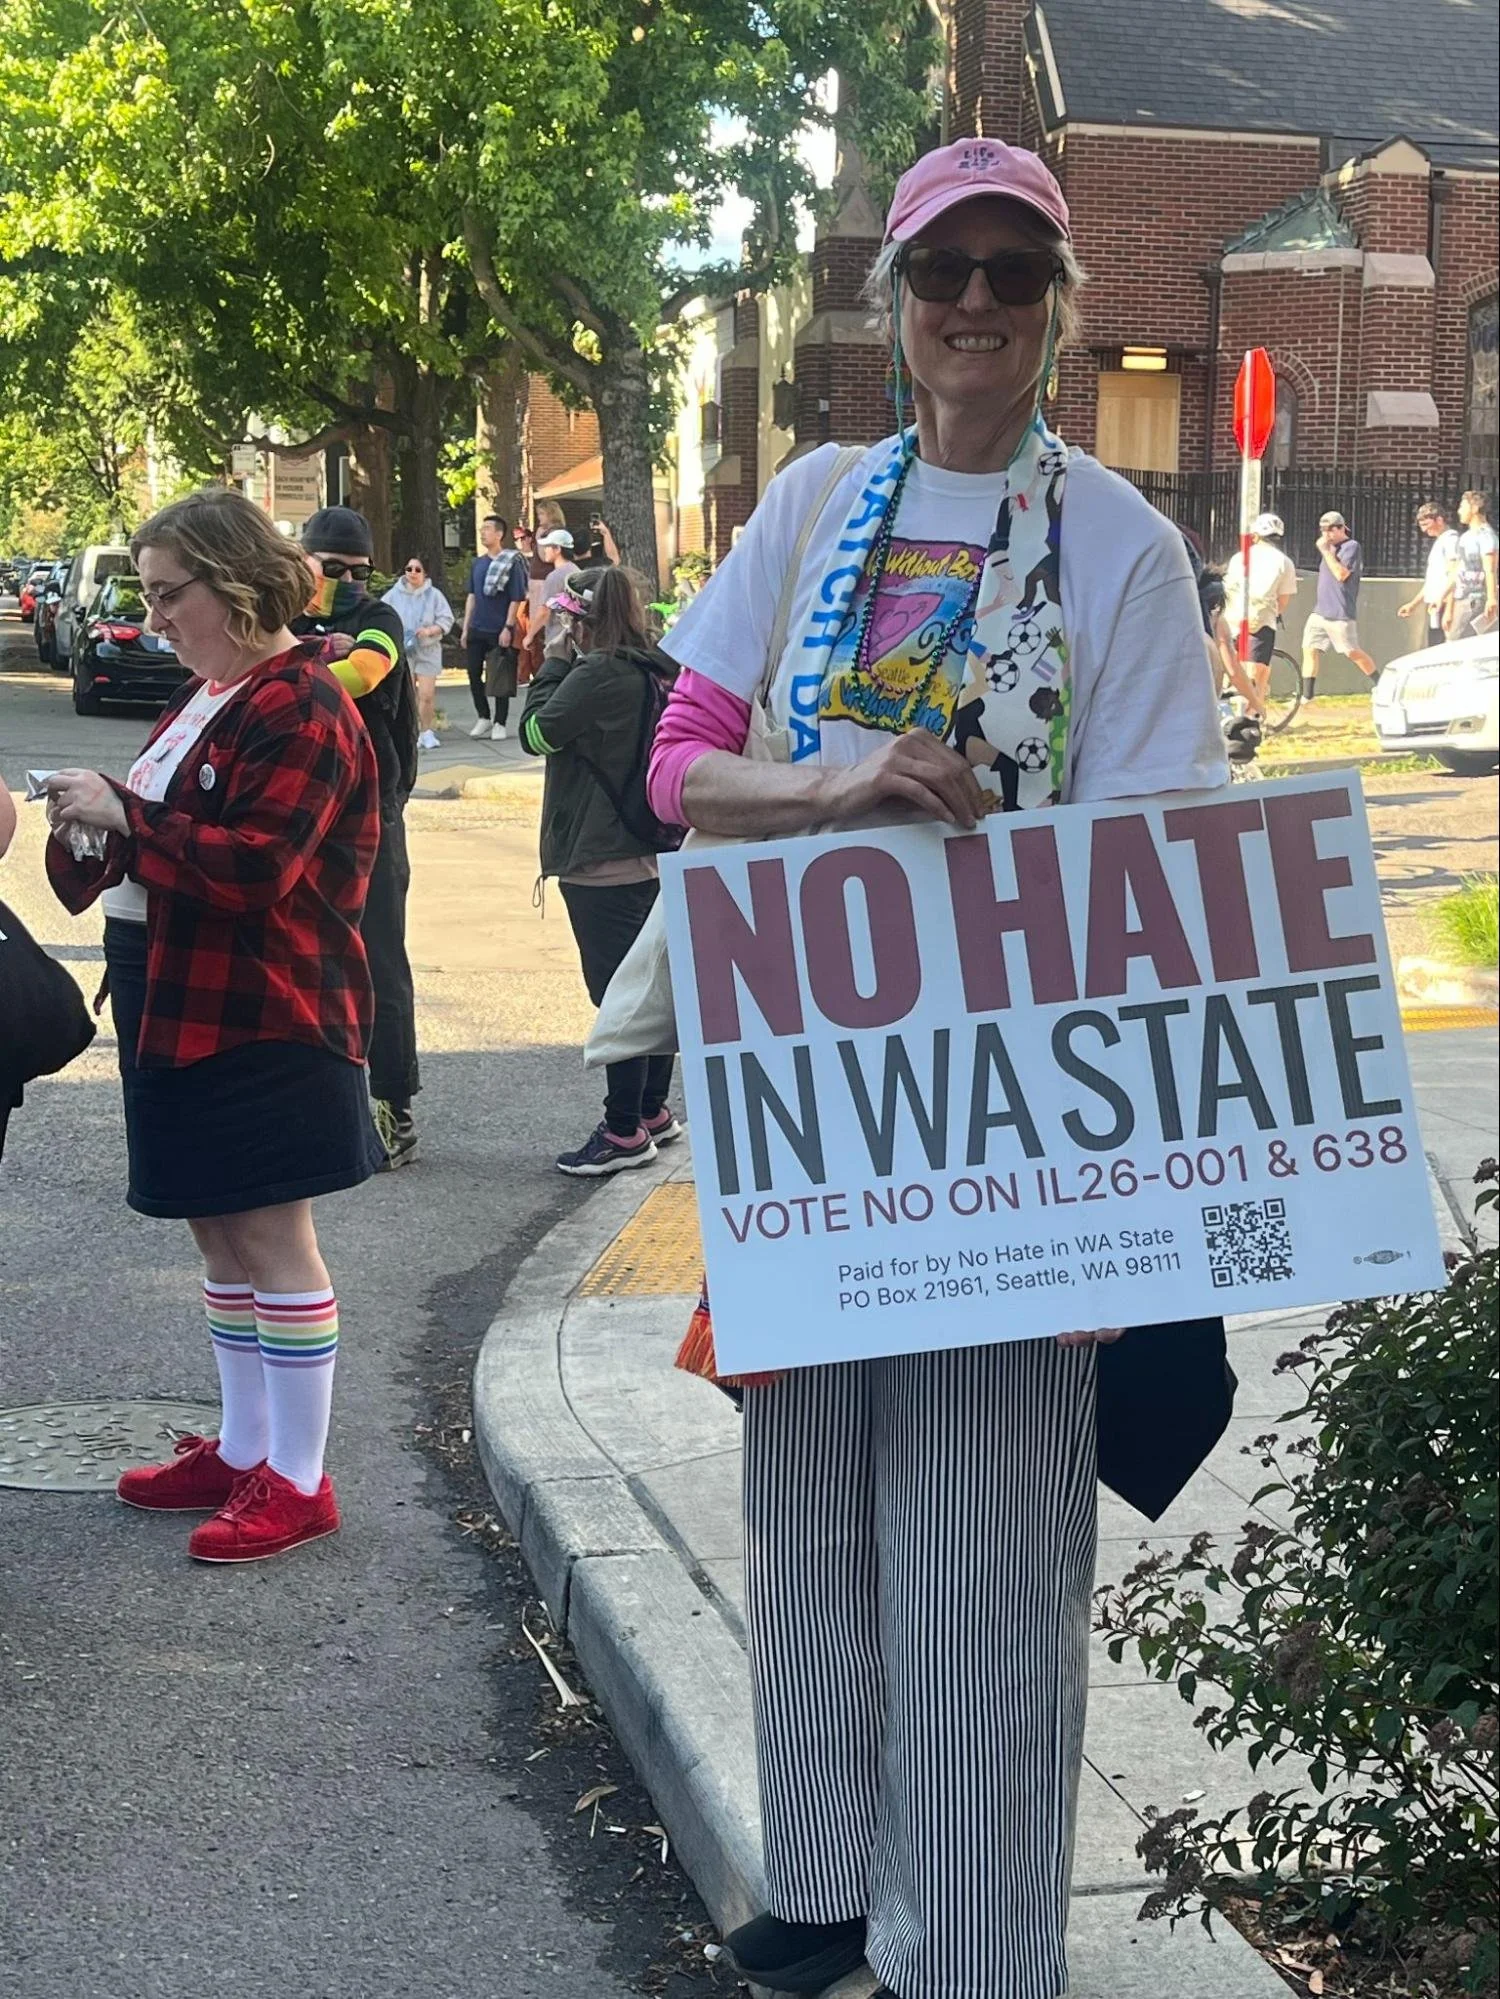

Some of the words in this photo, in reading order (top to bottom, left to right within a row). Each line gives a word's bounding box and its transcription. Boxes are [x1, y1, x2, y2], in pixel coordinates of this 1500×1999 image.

[683, 846, 921, 1045] NO
[944, 786, 1377, 1014] HATE
[705, 1045, 826, 1196] IN
[836, 1022, 1045, 1177] WA
[1051, 974, 1403, 1151] STATE
[721, 1194, 850, 1243] VOTE
[863, 1184, 933, 1227] NO
[949, 1173, 1020, 1215] ON
[1037, 1145, 1247, 1206] IL26-001
[1268, 1140, 1299, 1177] &
[1313, 1126, 1407, 1172] 638
[839, 1260, 884, 1283] Paid
[890, 1258, 919, 1276] for
[926, 1254, 950, 1275] by
[958, 1249, 988, 1268] No
[995, 1244, 1044, 1264] Hate
[1050, 1239, 1069, 1256] in
[1075, 1233, 1112, 1254] WA
[1119, 1228, 1174, 1249] State
[839, 1290, 870, 1311] PO
[877, 1287, 917, 1306] Box
[924, 1276, 988, 1300] 21961,
[996, 1267, 1075, 1291] Seattle,
[1081, 1260, 1119, 1280] WA
[1125, 1252, 1180, 1275] 98111
